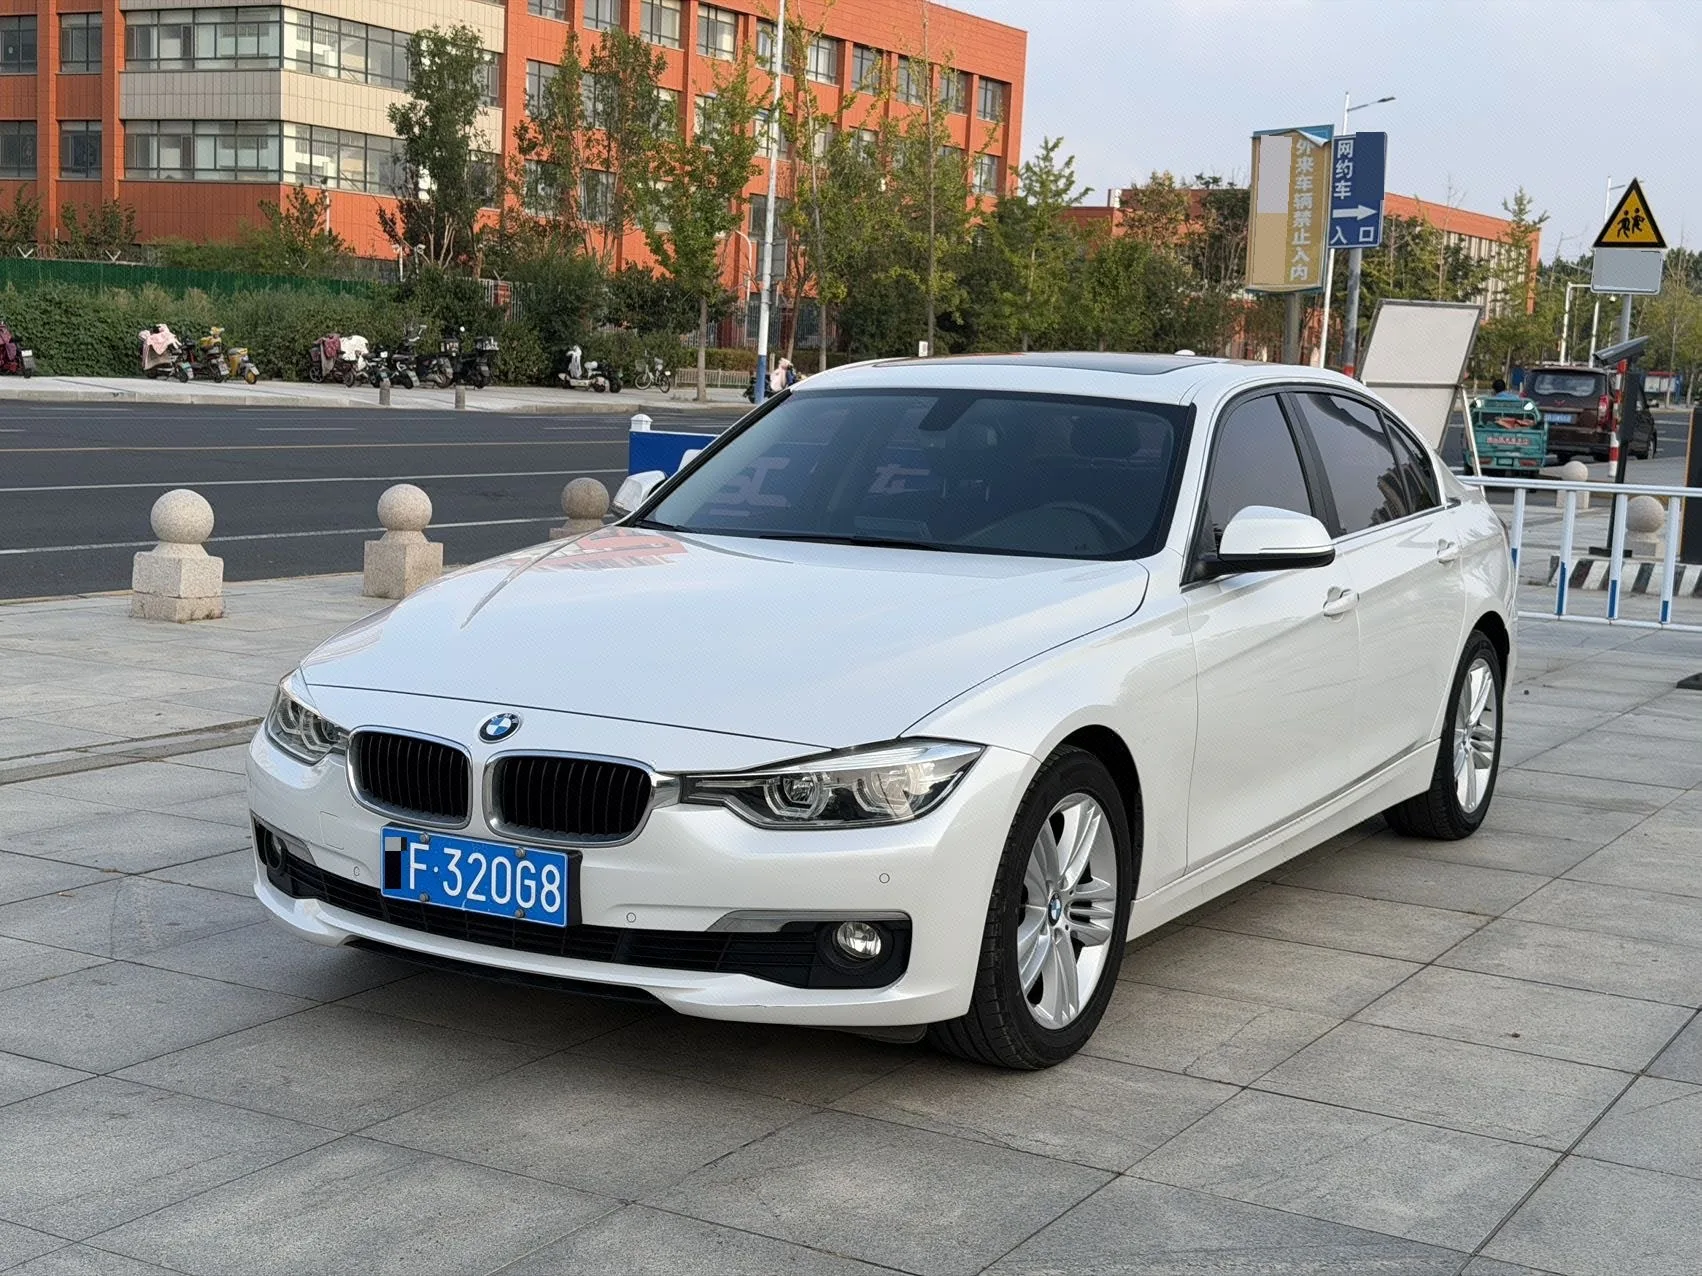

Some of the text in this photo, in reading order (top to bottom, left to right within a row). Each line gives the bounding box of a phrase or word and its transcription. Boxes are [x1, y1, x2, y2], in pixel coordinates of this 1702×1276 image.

[1334, 139, 1354, 200] 网约车
[1291, 138, 1314, 281] 外来车辆禁止入内
[1330, 226, 1375, 245] 入口
